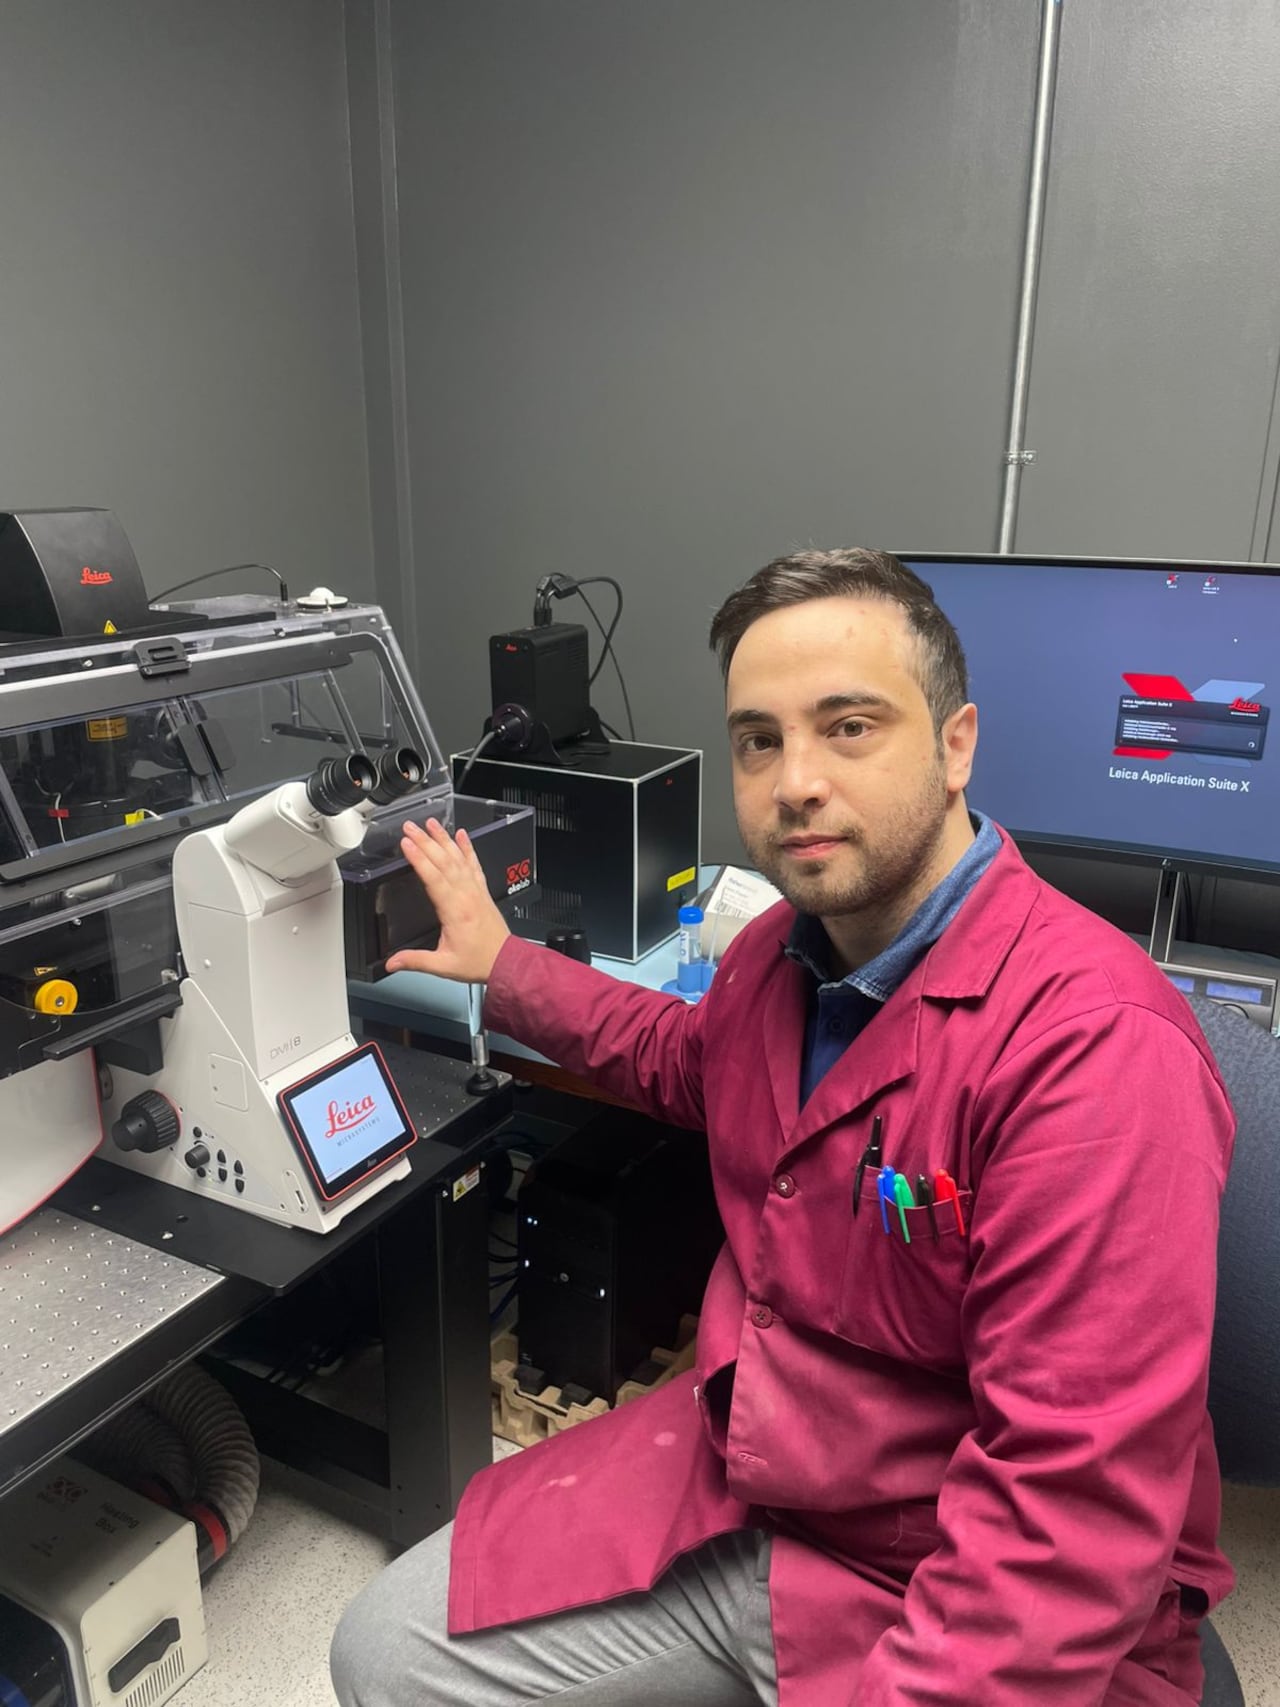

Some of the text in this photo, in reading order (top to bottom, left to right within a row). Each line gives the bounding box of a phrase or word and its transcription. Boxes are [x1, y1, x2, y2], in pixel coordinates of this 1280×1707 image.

[80, 566, 113, 585] Leica
[1228, 696, 1261, 713] Leica
[1109, 767, 1250, 792] Leica Application Suite X
[508, 878, 530, 895] okolab
[325, 1095, 377, 1139] Leica
